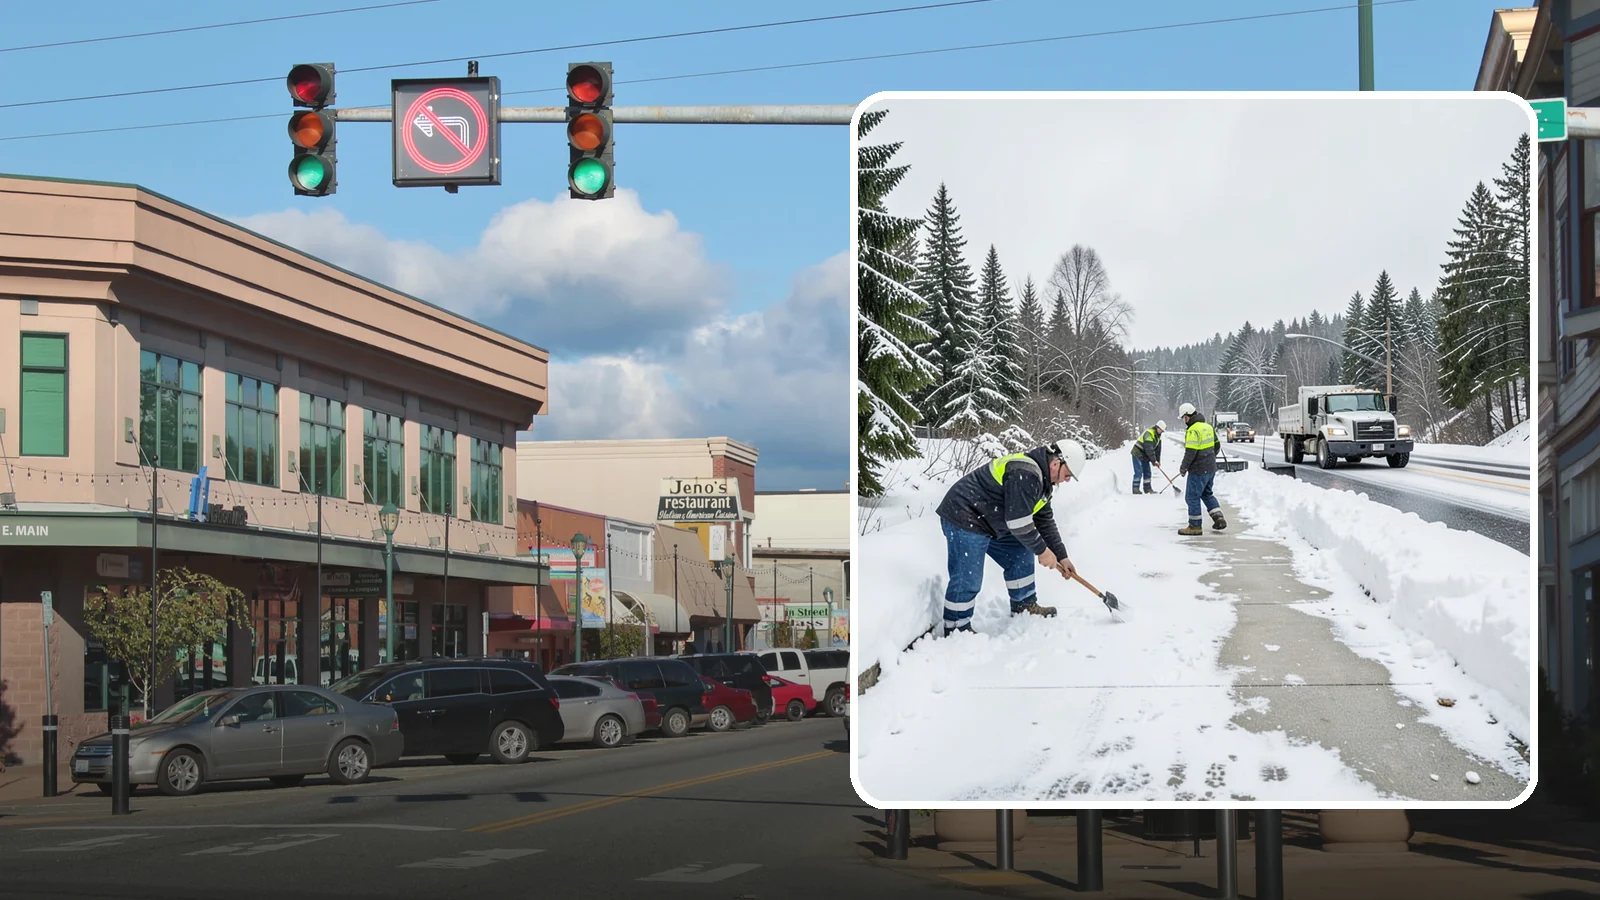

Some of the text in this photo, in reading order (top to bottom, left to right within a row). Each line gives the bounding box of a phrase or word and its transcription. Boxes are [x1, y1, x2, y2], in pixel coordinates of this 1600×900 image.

[670, 480, 728, 494] Jeno's
[665, 496, 731, 509] restaurant
[659, 510, 681, 519] Italian
[686, 510, 714, 519] American
[715, 509, 738, 519] Cuisine
[2, 525, 49, 536] E. MAIN
[797, 607, 829, 617] Street
[791, 619, 824, 627] lass
